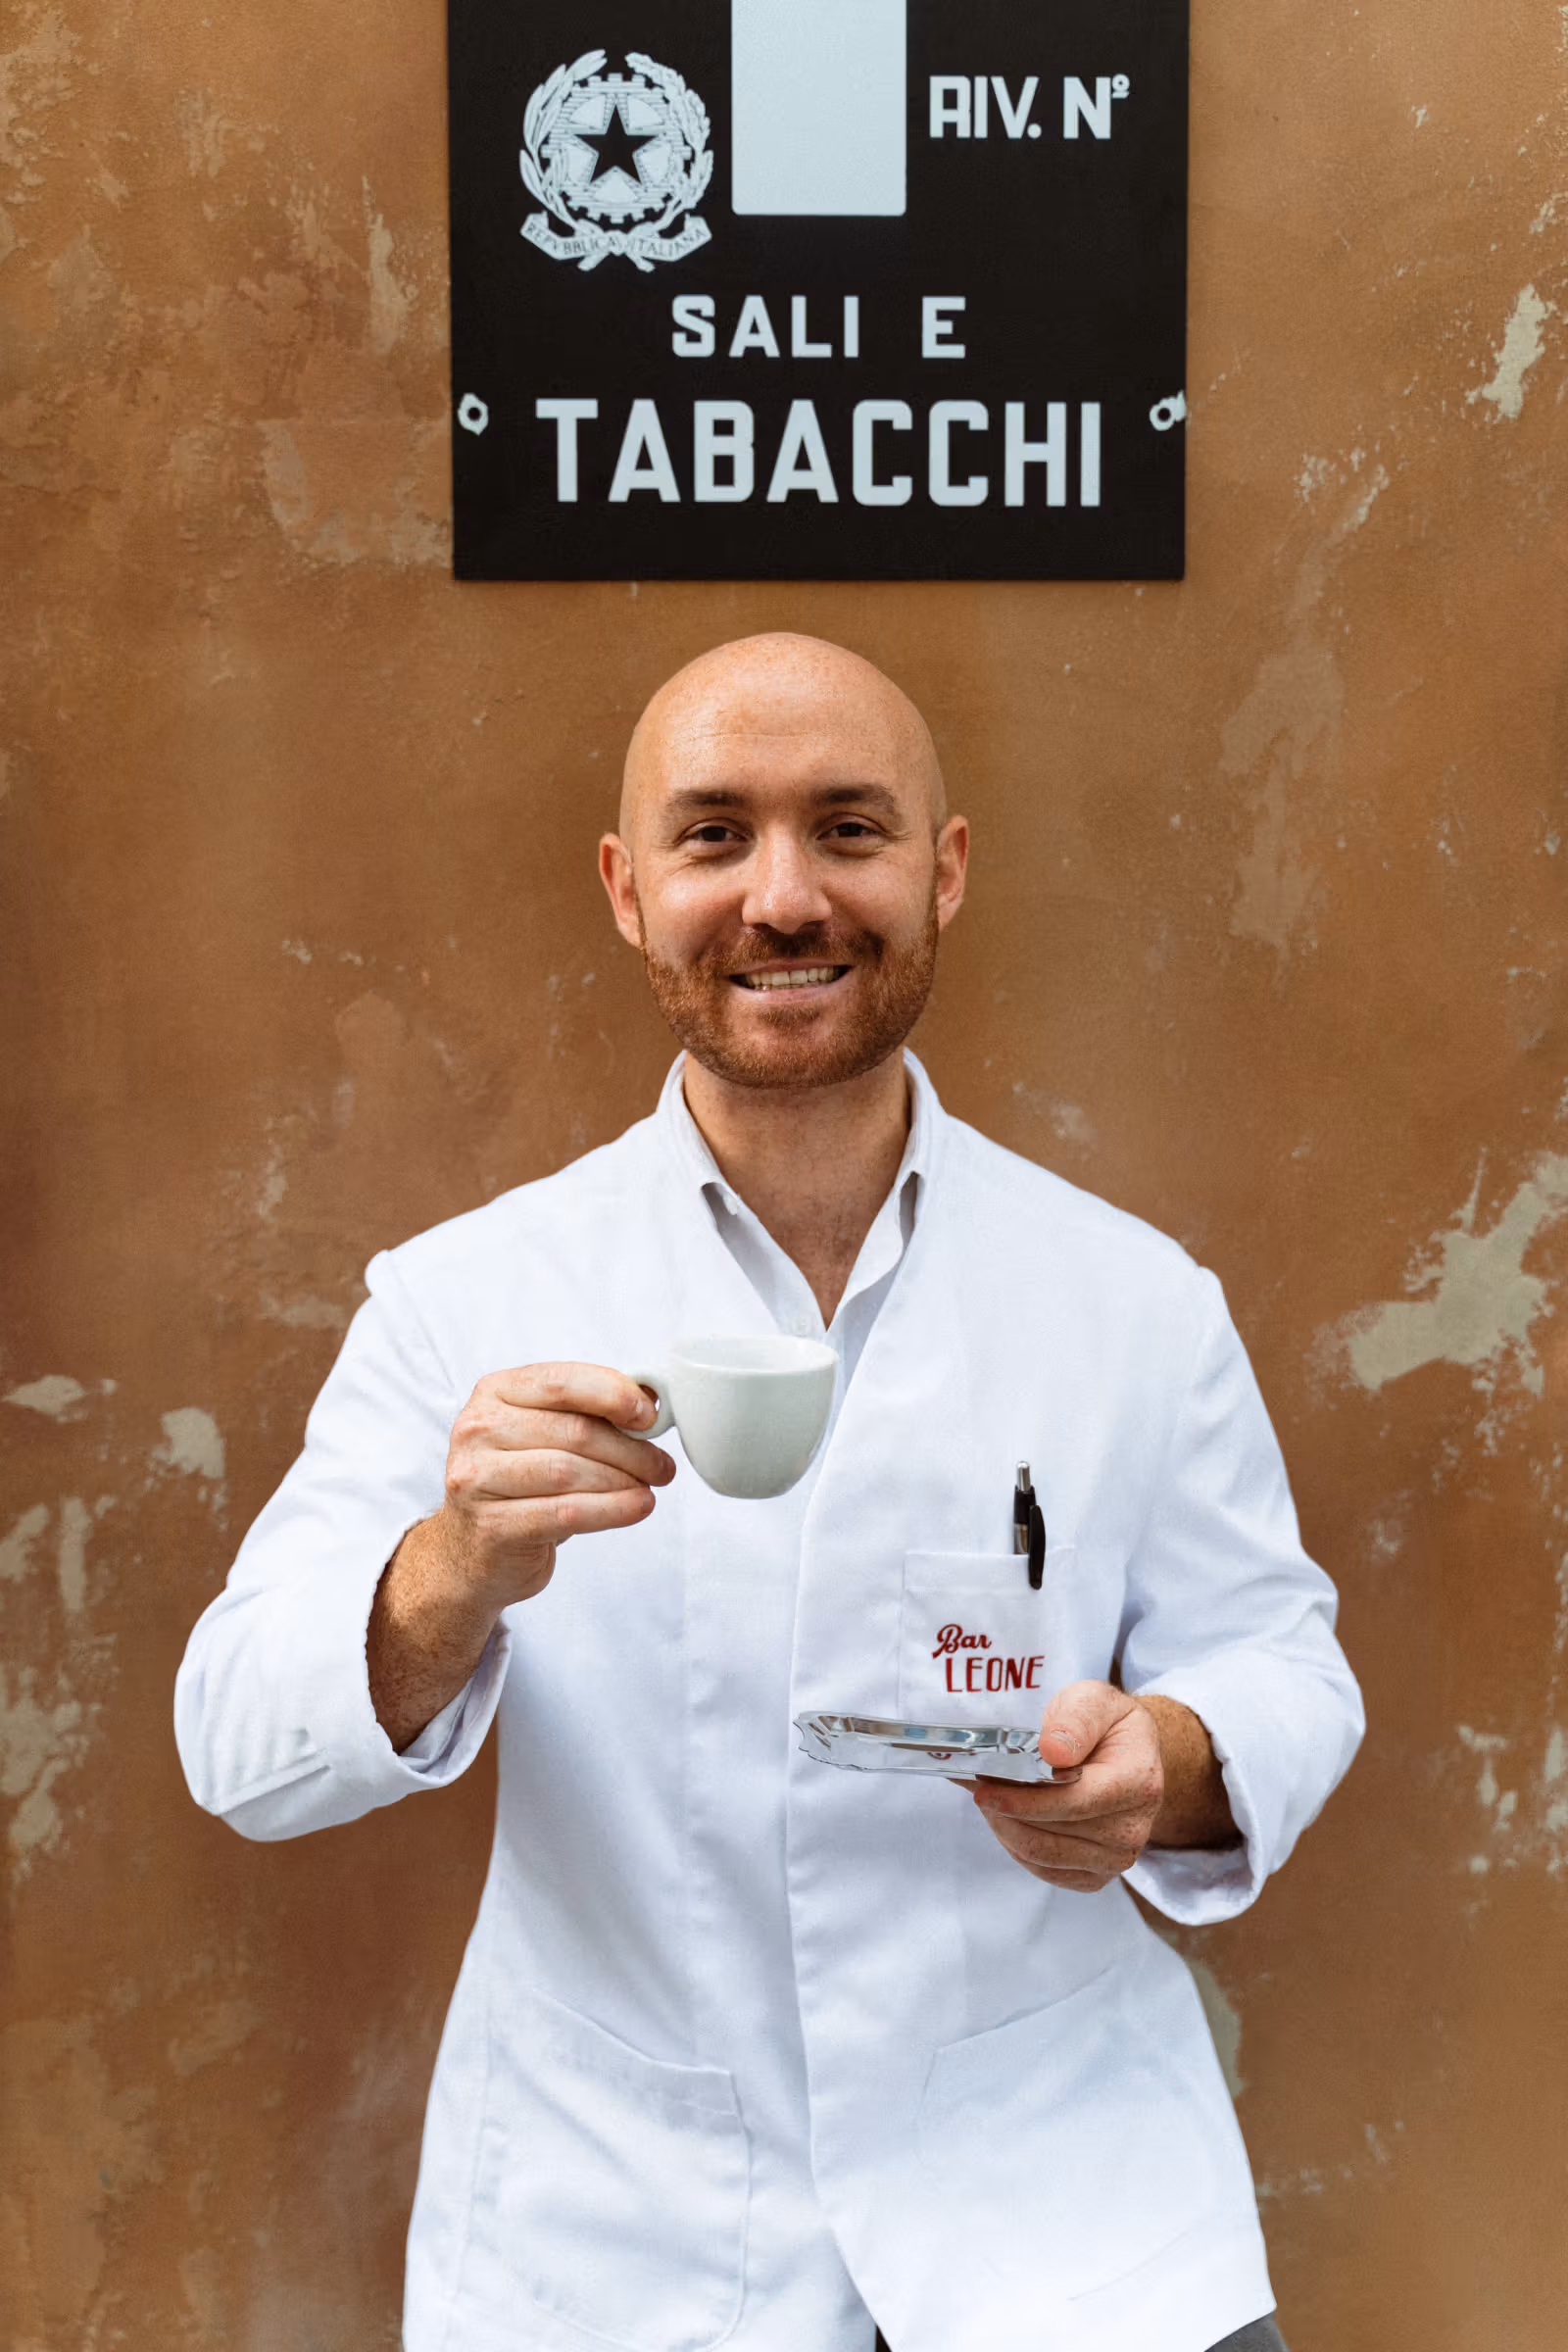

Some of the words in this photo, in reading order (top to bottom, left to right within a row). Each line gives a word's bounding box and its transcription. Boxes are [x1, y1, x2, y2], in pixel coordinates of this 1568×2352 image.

[671, 295, 859, 358] SALI
[922, 296, 966, 359] E
[535, 398, 1101, 507] TABACCHI
[932, 1623, 992, 1659] Bar
[945, 1654, 1045, 1692] LEONE
